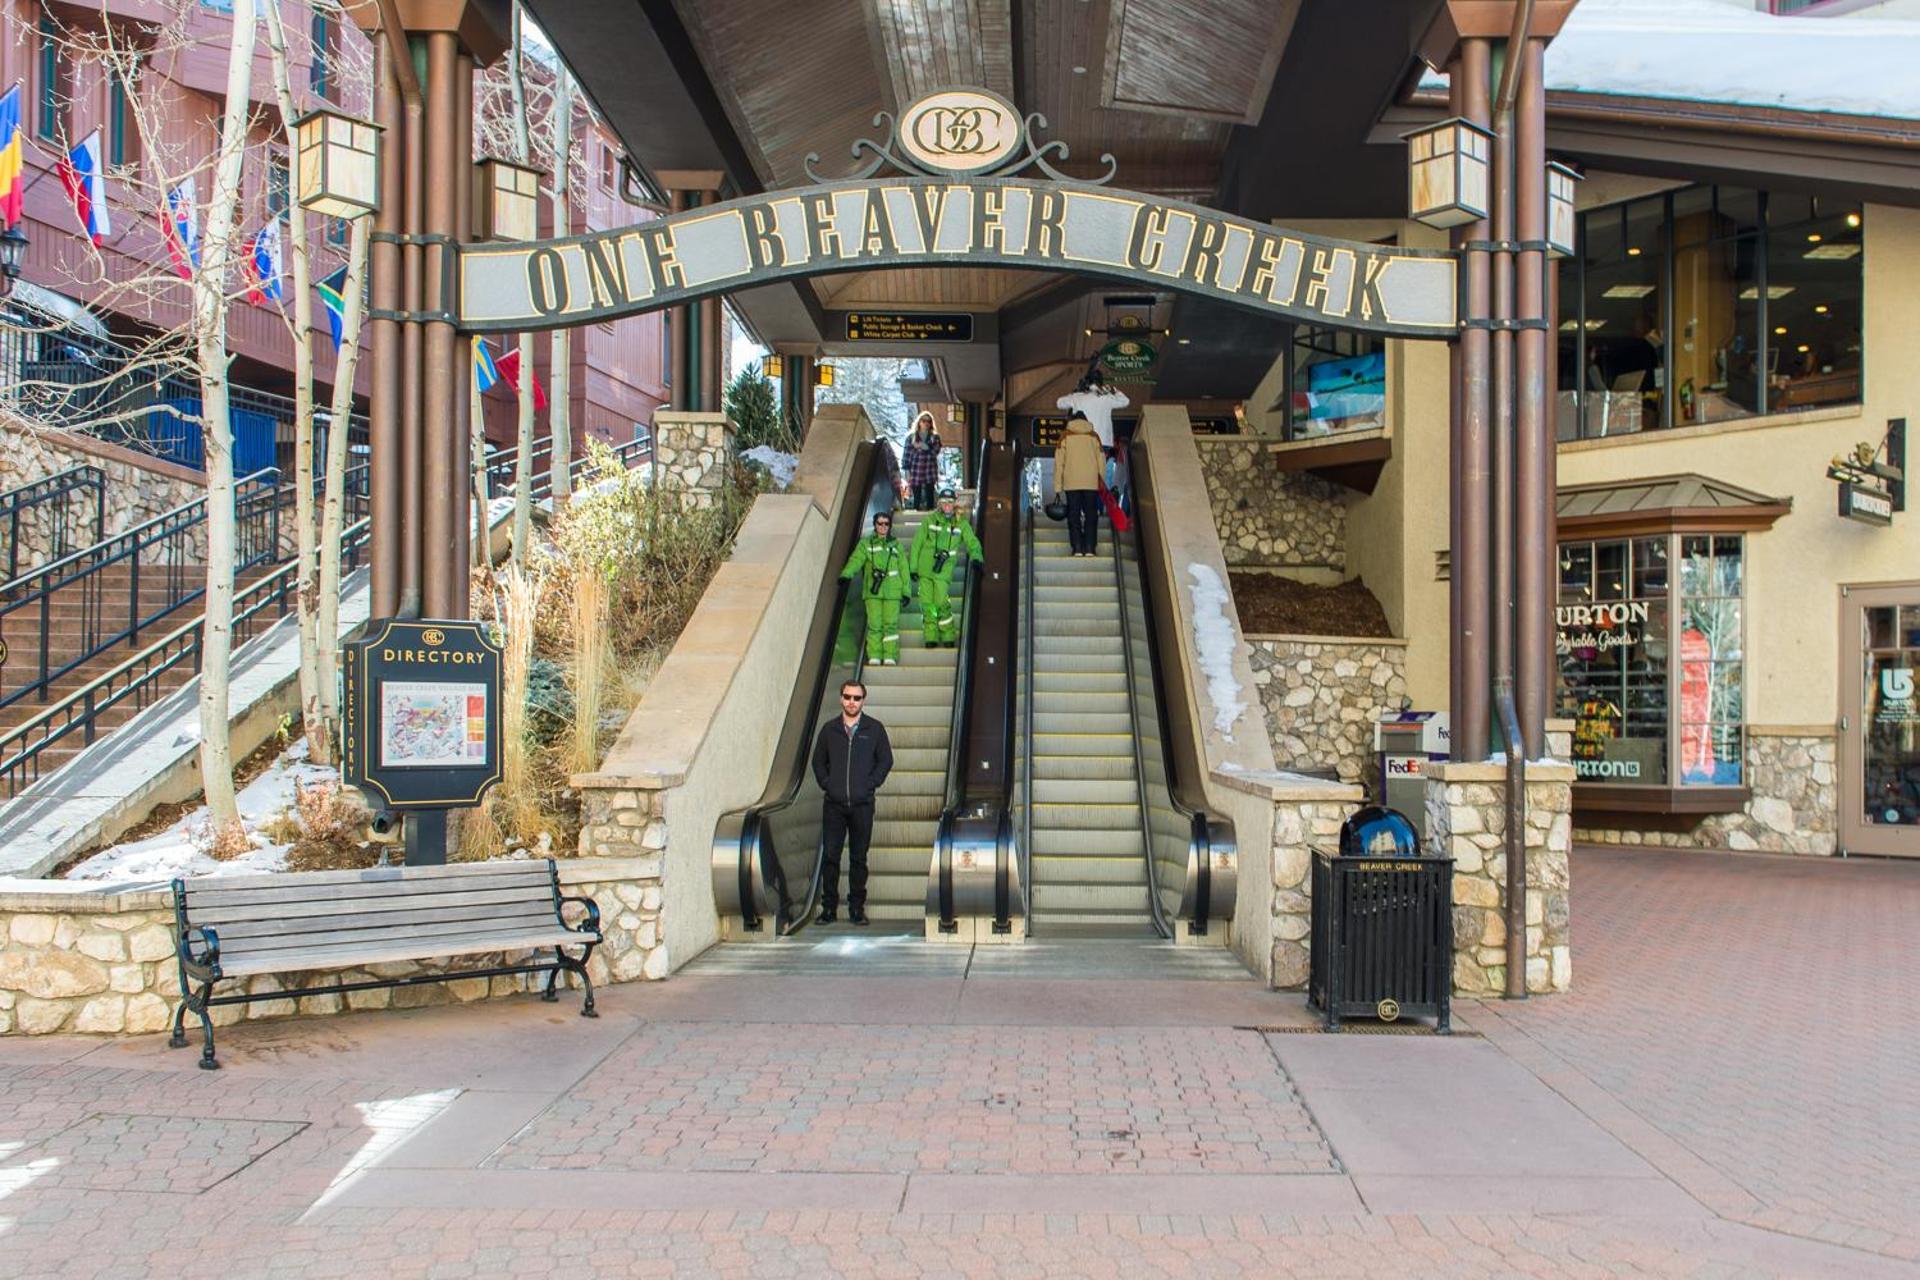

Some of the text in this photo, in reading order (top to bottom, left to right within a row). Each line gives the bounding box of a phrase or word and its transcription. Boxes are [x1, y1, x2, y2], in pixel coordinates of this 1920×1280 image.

[527, 186, 1390, 324] ONE BEAVER CREEK
[863, 323, 880, 331] Public
[1556, 602, 1649, 626] URTON
[384, 649, 486, 664] DIRECTORY
[1388, 759, 1420, 773] FedE
[1360, 862, 1422, 872] BEAVER CREEK
